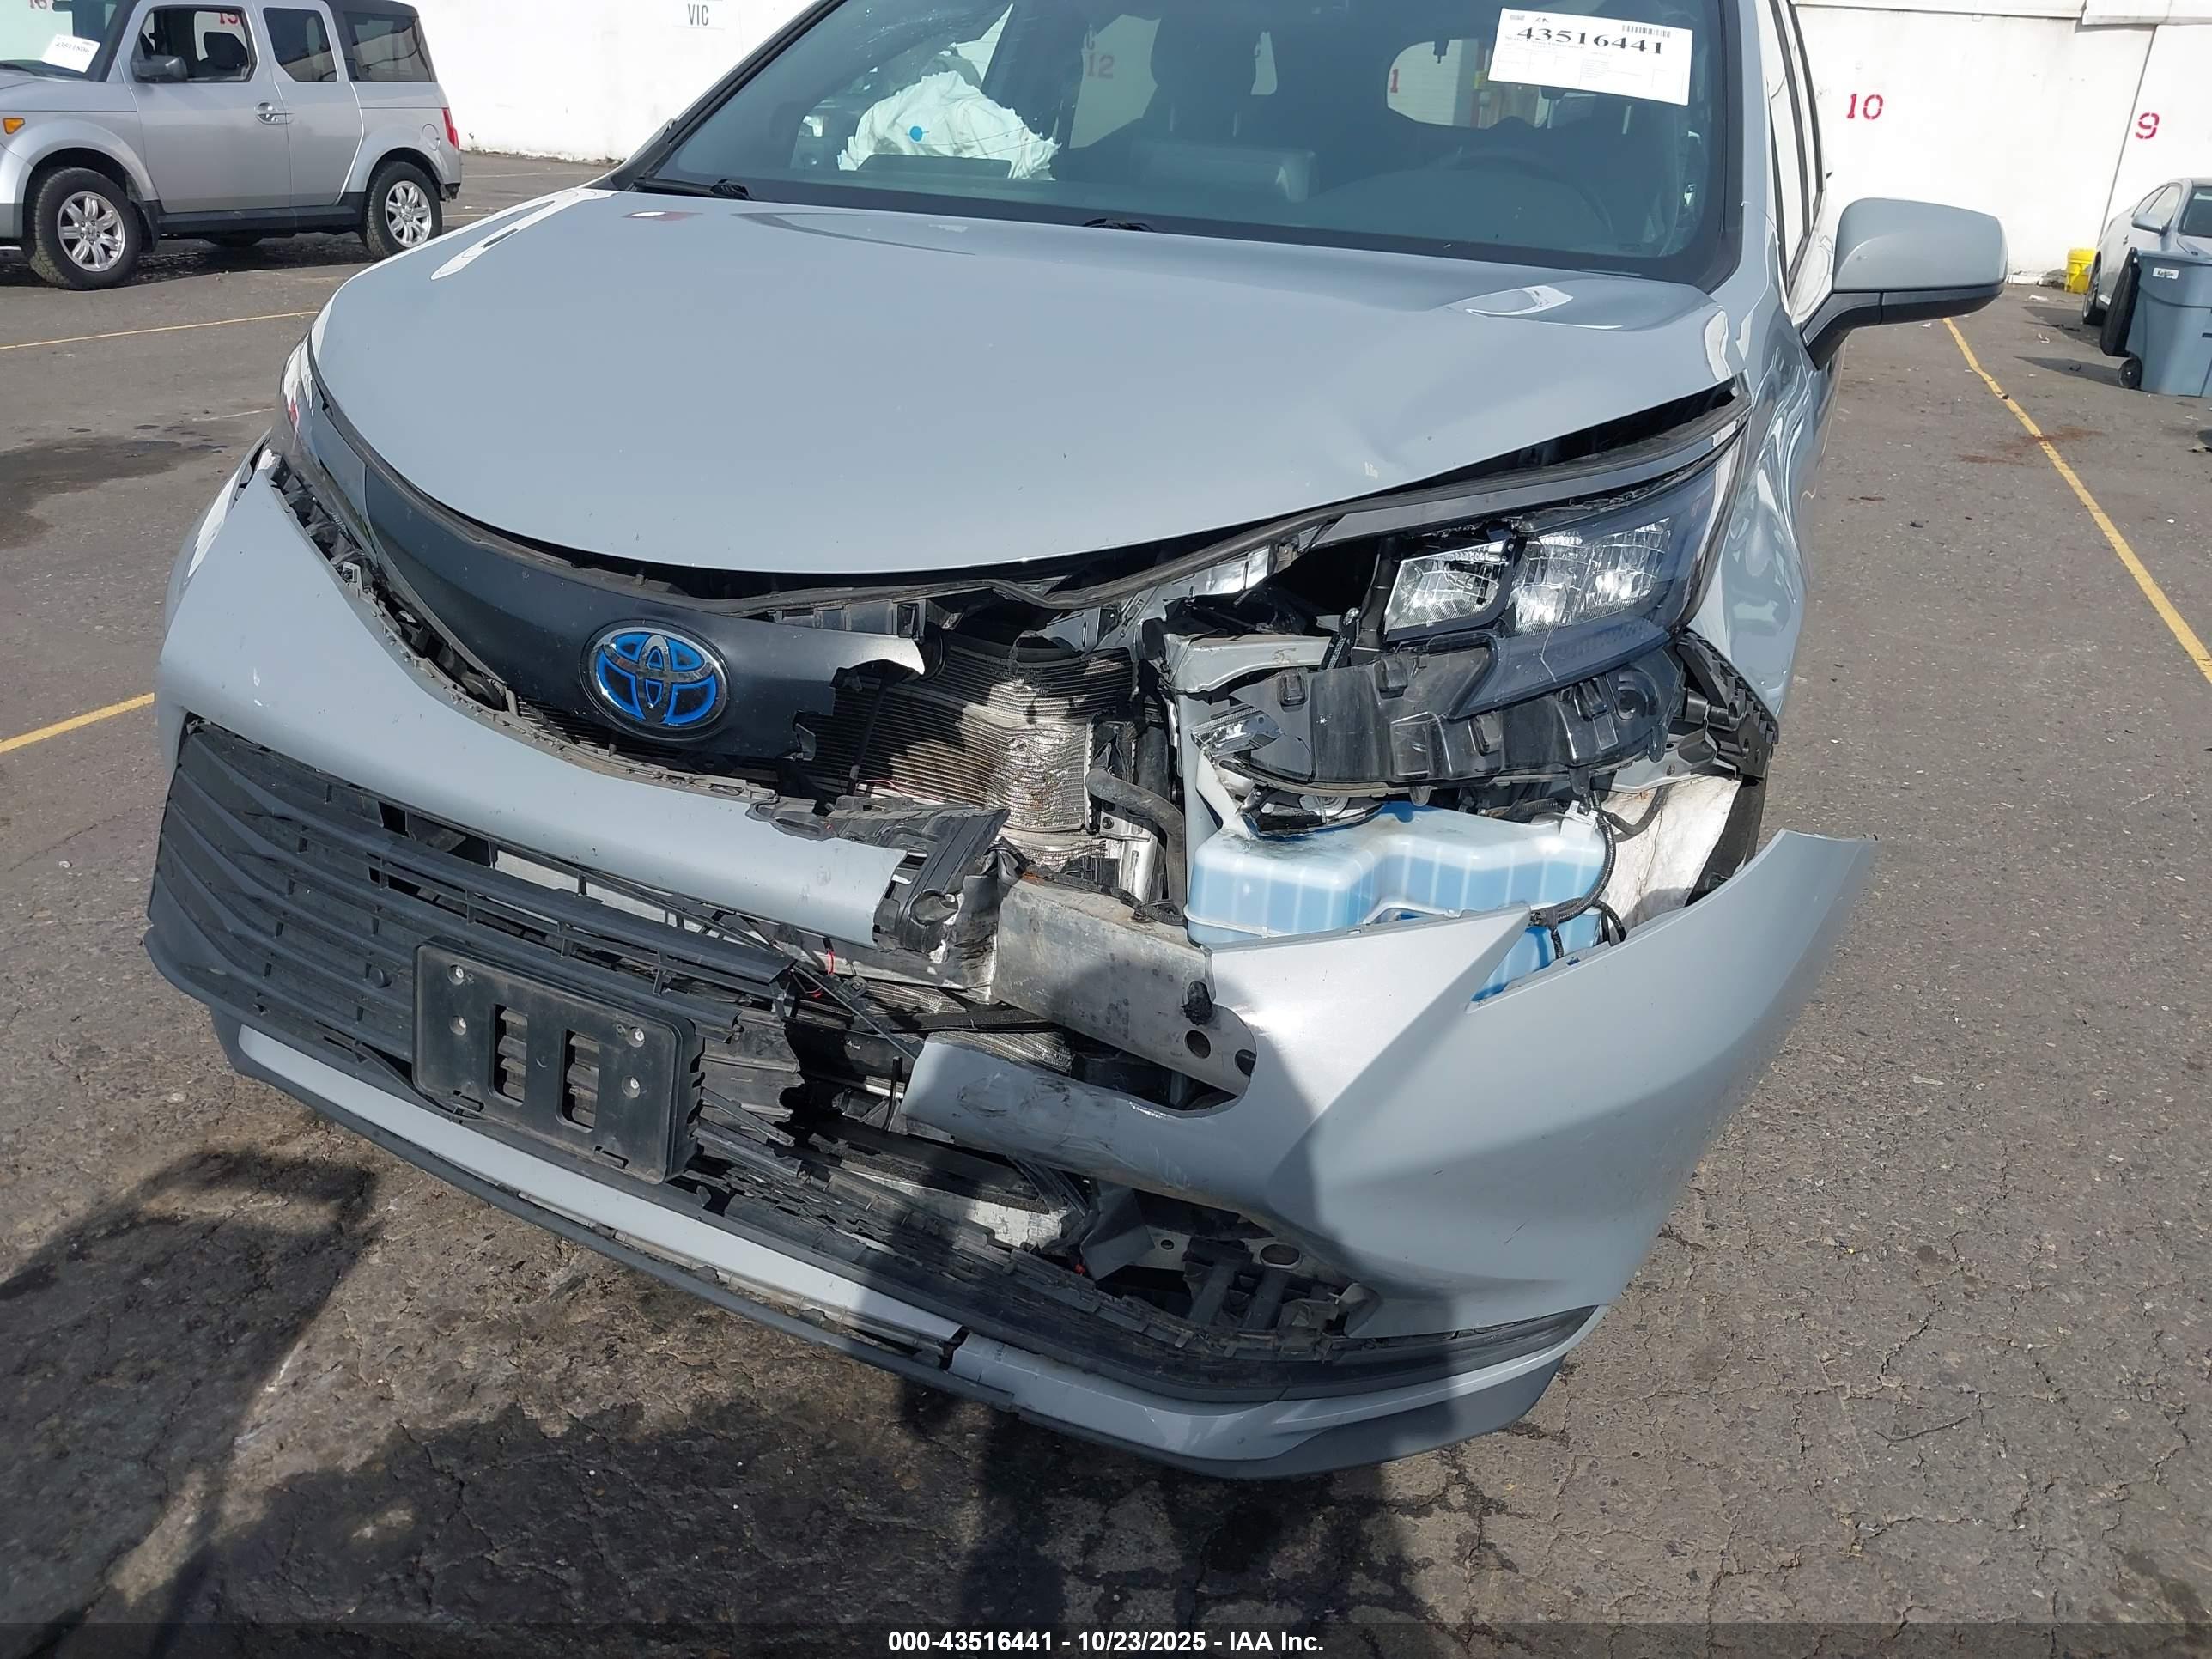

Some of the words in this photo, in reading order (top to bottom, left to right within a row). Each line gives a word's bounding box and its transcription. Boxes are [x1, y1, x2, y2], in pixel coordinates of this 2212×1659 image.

[687, 3, 708, 26] VIC
[1517, 27, 1662, 54] 43516441
[1086, 54, 1115, 79] 12
[1847, 94, 1883, 120] 10
[2135, 112, 2160, 139] 9
